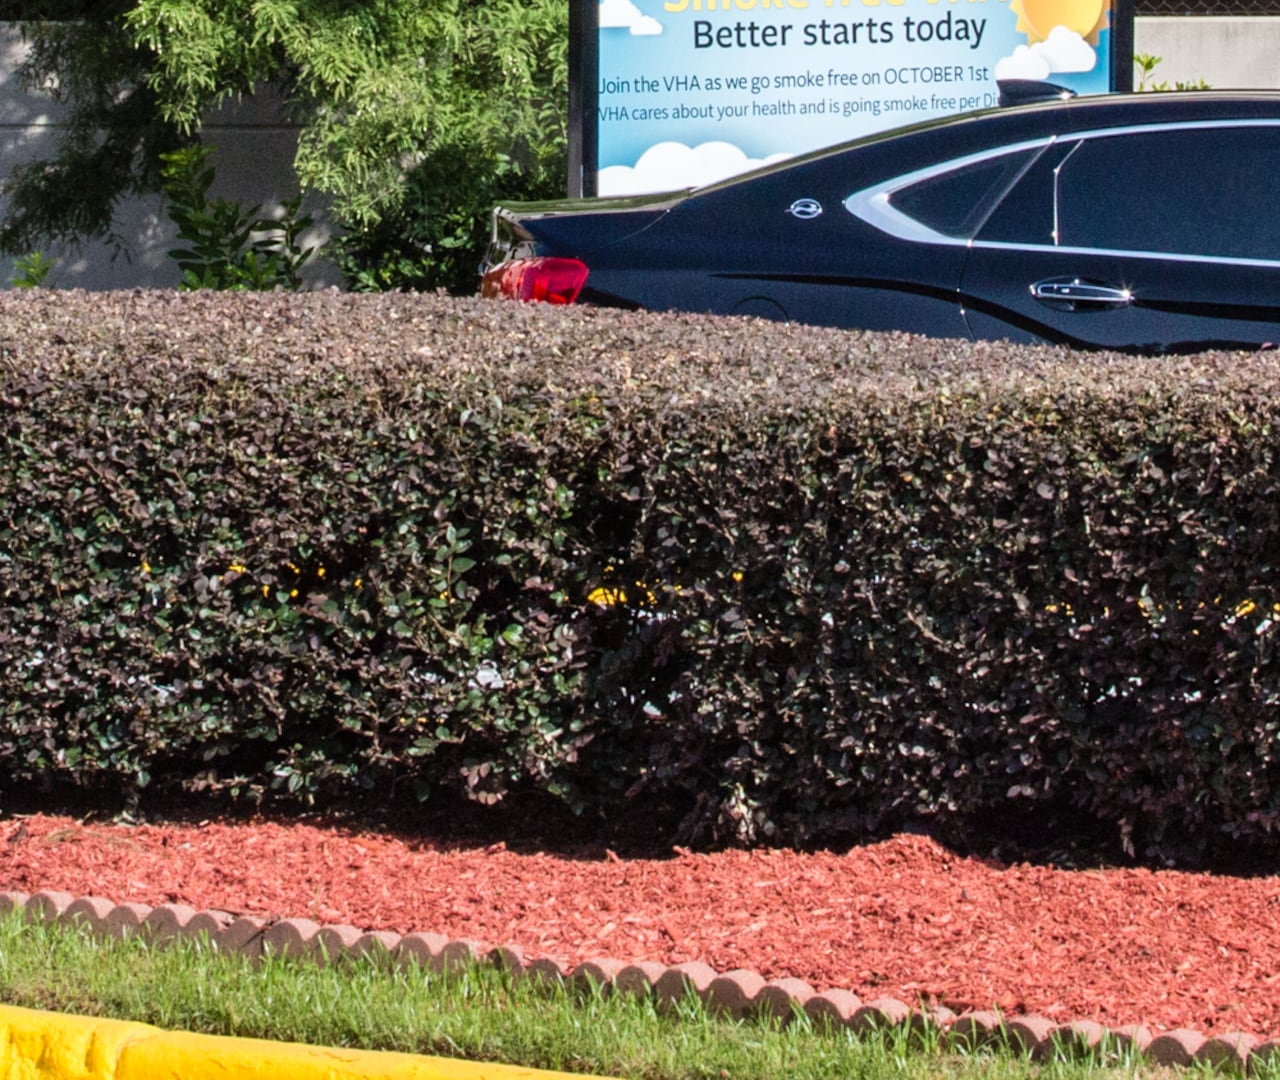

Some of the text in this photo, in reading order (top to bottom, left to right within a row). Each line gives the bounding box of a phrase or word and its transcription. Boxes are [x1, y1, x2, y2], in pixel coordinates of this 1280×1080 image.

[693, 10, 987, 50] Better starts today
[598, 65, 990, 95] Join the VHA as we go smoke free on OCTOBER 1st
[598, 92, 1000, 122] VHA cares about your health and is going smoke free per Di
